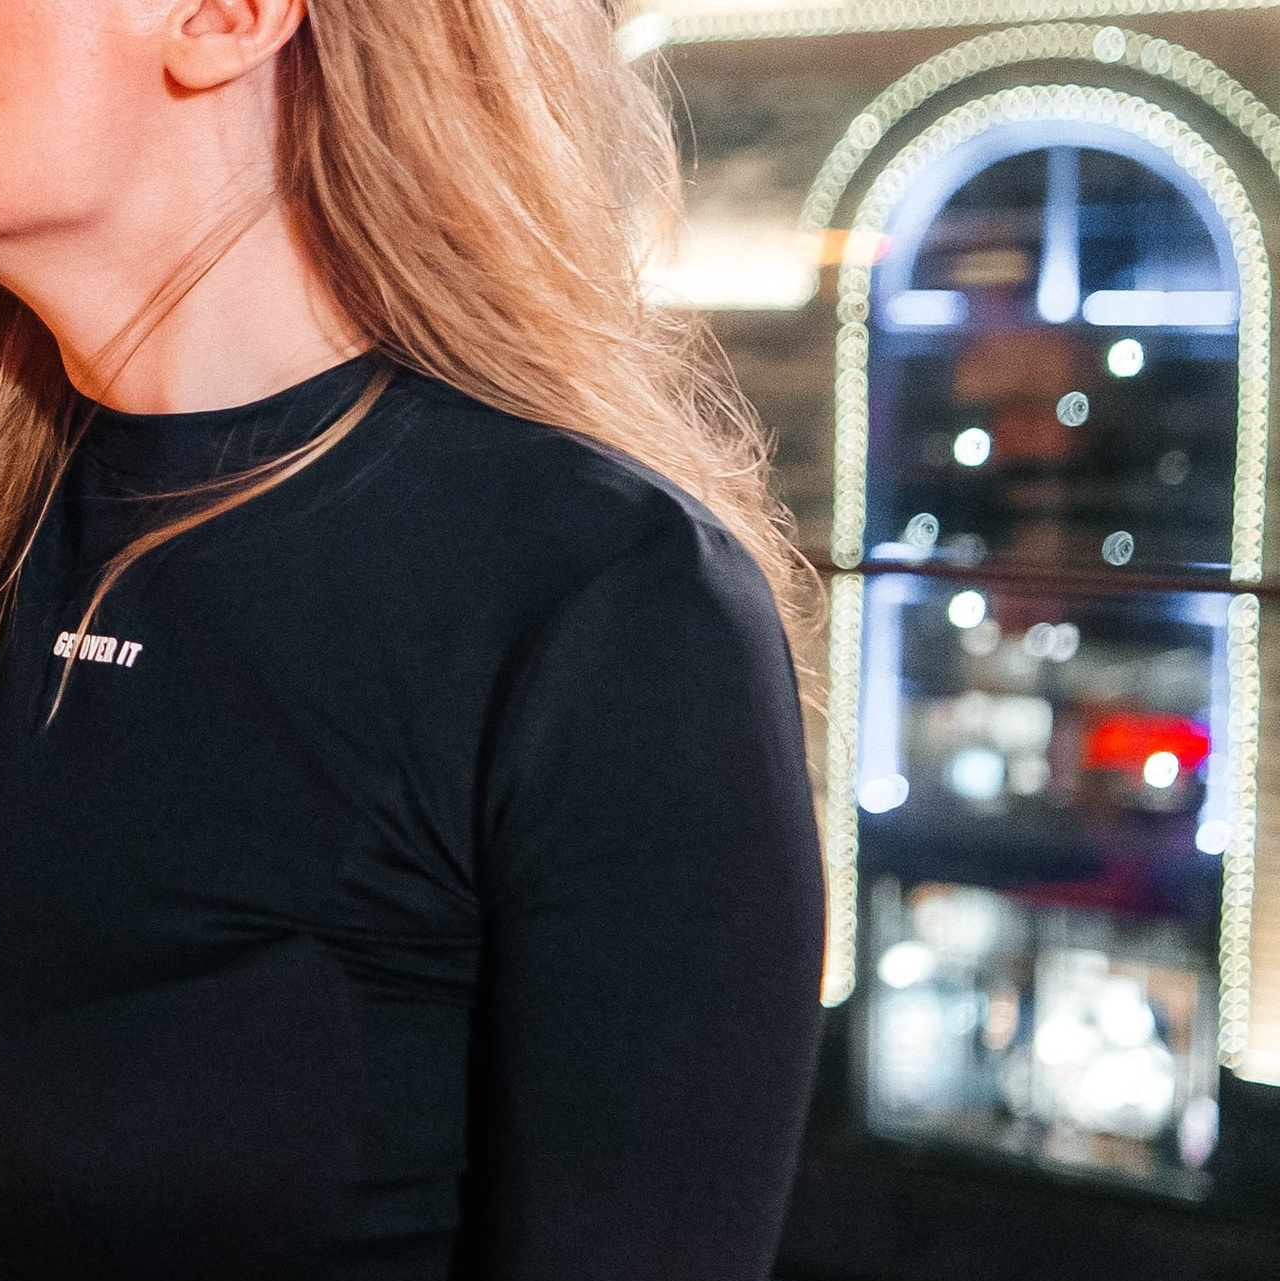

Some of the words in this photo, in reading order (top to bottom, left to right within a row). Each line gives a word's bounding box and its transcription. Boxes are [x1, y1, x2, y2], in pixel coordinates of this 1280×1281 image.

[53, 631, 81, 659] GE
[79, 634, 118, 663] OVER
[116, 640, 143, 668] IT
